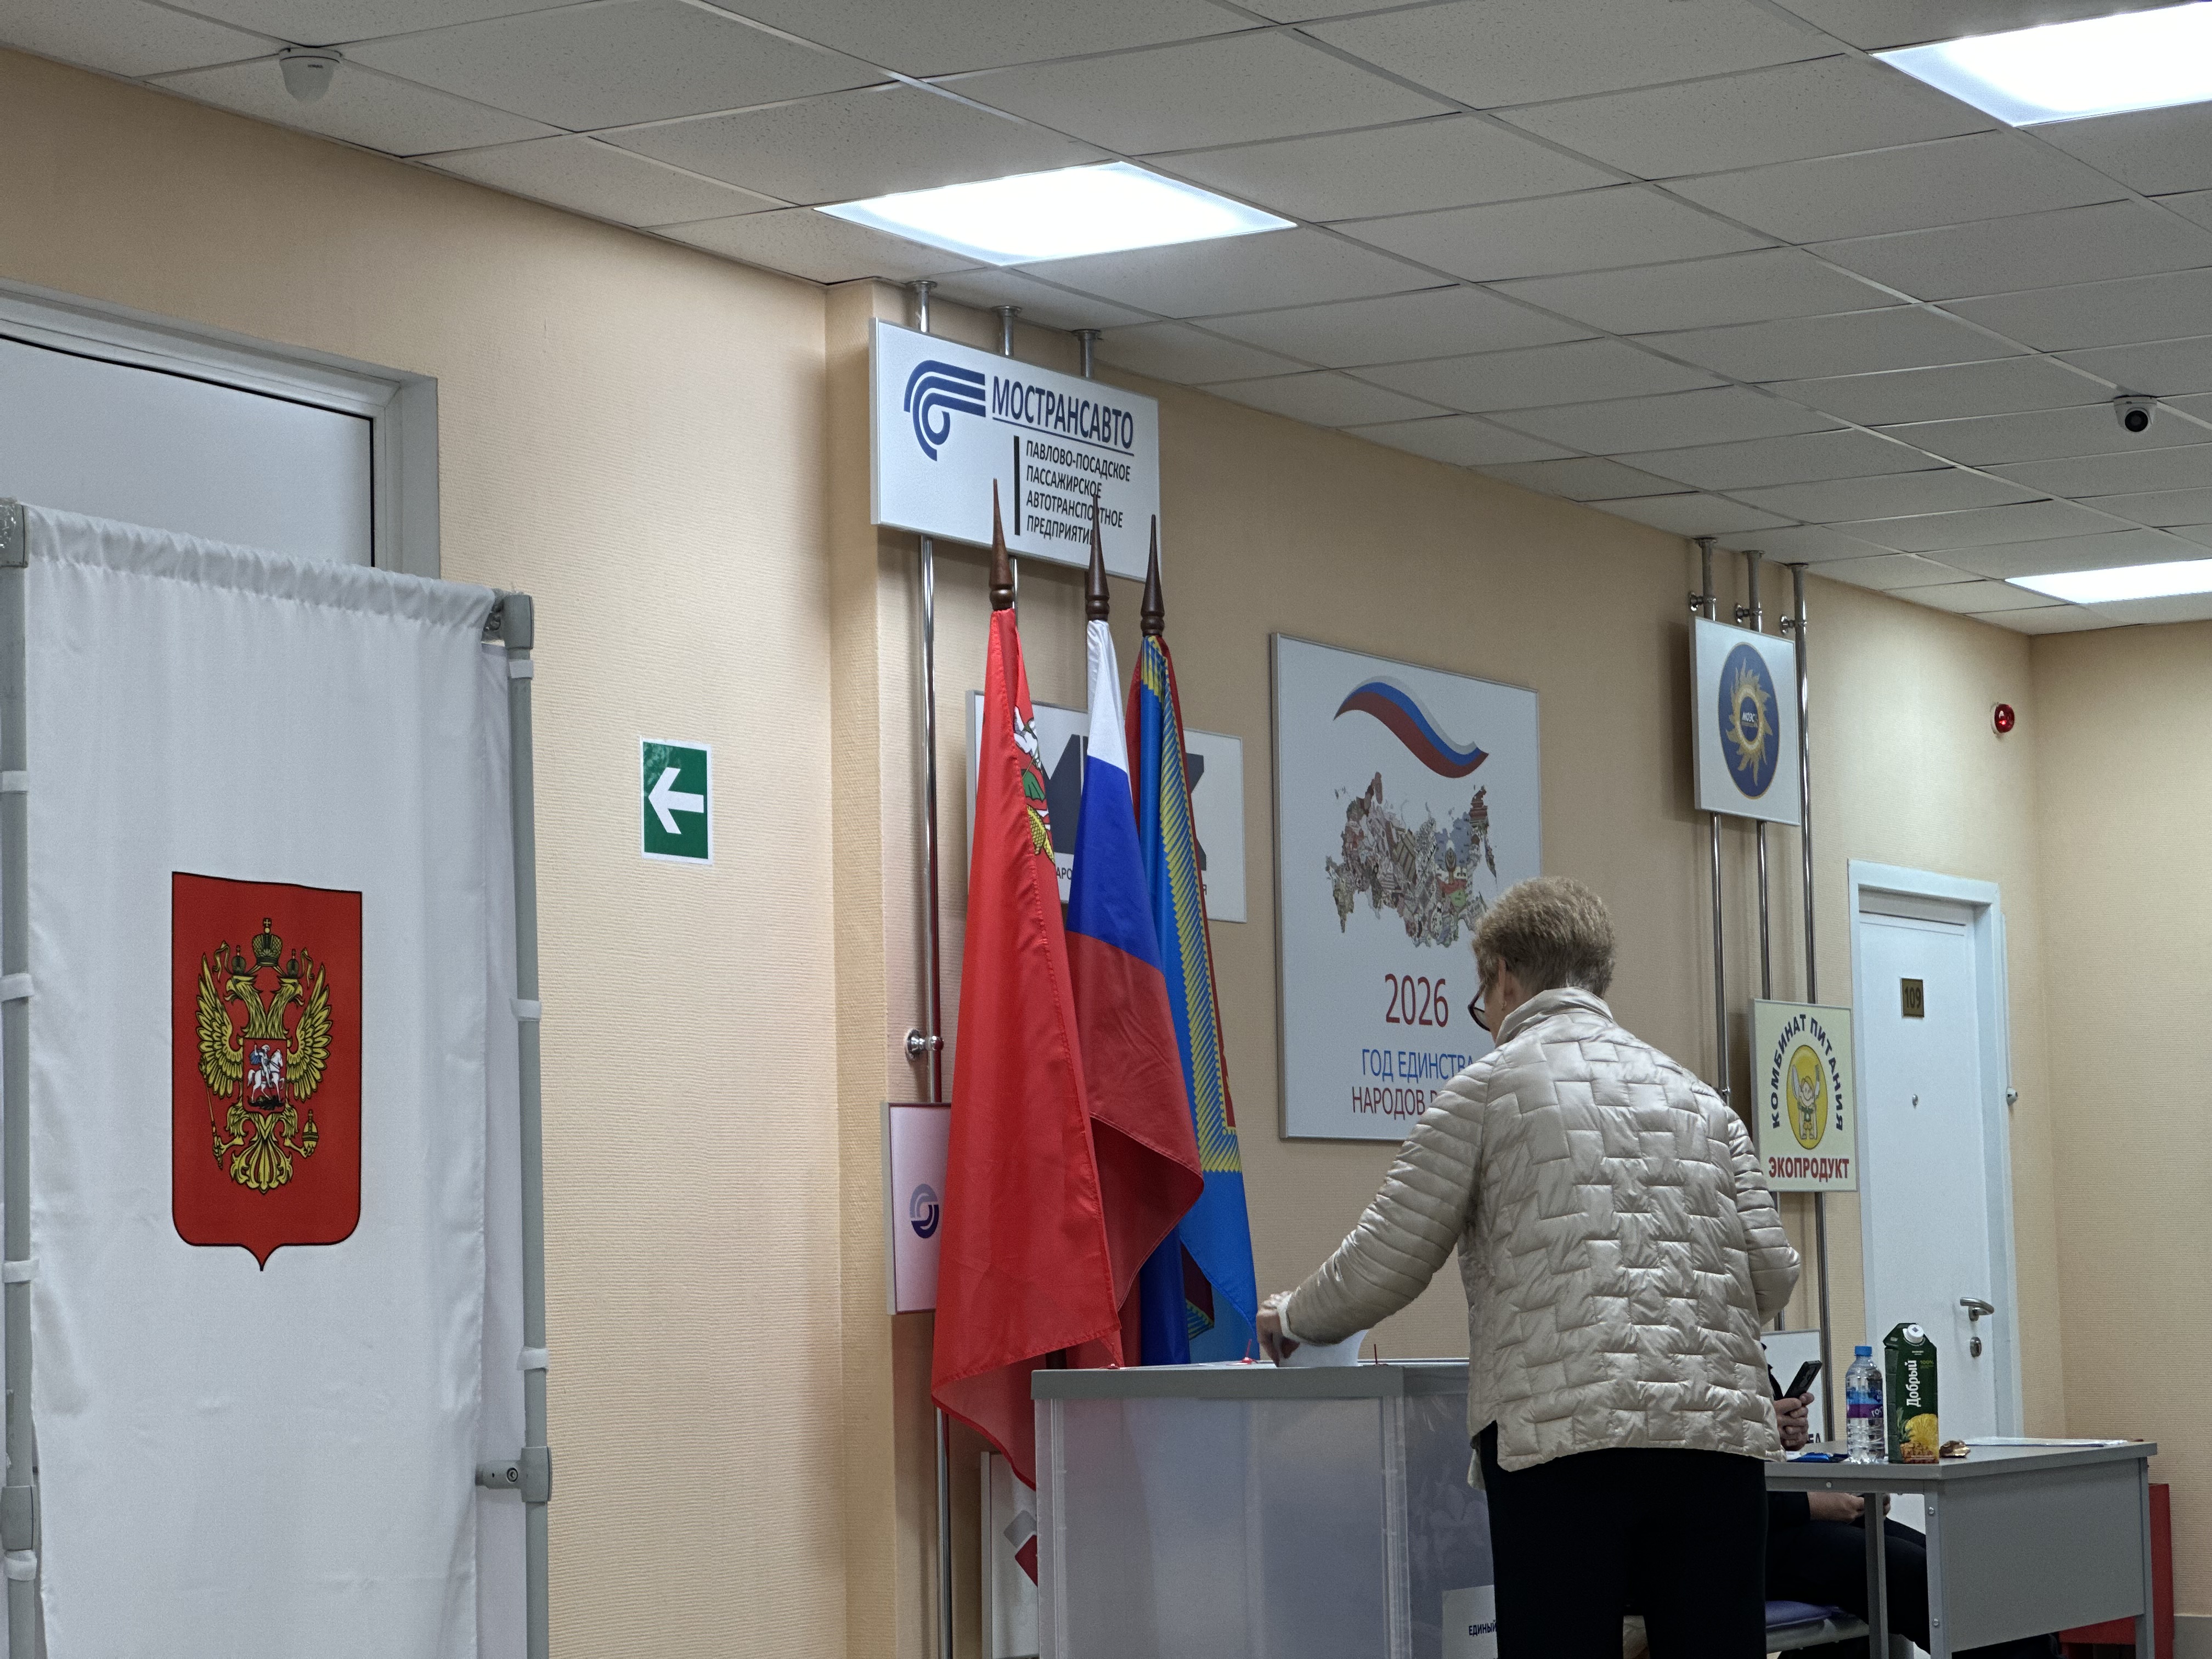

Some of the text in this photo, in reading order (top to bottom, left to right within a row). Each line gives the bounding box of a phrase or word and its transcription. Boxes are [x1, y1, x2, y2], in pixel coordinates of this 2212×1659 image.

[992, 376, 1134, 449] МОСТРАНСАВТО
[1026, 440, 1131, 482] ПАВЛОВО-ПОСАДСКОЕ
[1026, 465, 1102, 499] ПАССАЖИРСКОЕ
[1026, 490, 1124, 528] АВТОТРАНСПОТНОЕ
[1385, 974, 1449, 1028] 2026
[1904, 986, 1921, 1009] 109
[1362, 1049, 1394, 1082] ГОД
[1770, 1014, 1843, 1131] КОМБИНАТ ПИТАНИЯ
[1352, 1086, 1426, 1120] НАРОДОВ
[1768, 1156, 1849, 1182] ЭКОПРОДУКТ
[1904, 1359, 1922, 1408] Добрый
